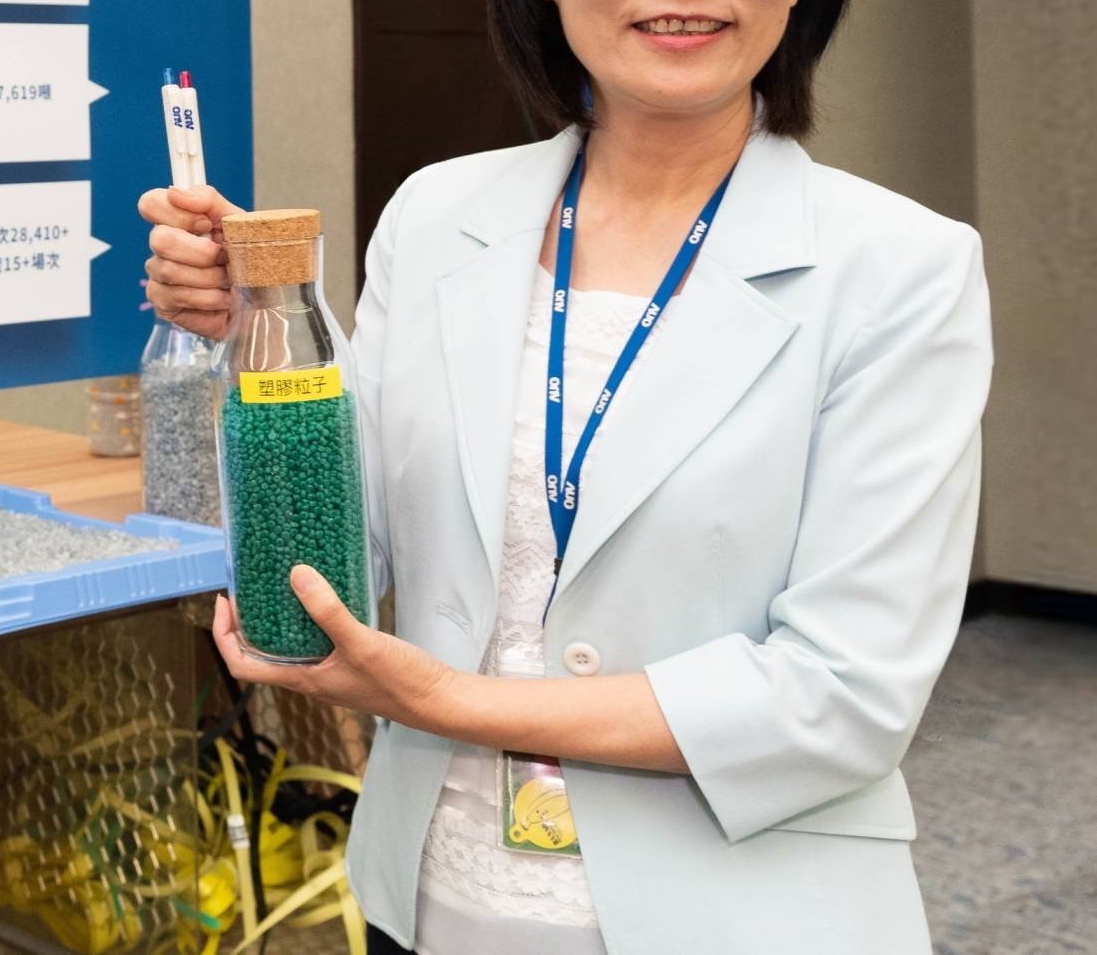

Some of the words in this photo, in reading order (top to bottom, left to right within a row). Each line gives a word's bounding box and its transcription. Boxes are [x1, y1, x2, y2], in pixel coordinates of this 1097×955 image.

[562, 207, 573, 229] AUO
[688, 219, 708, 244] AUO
[554, 289, 566, 313] AUO
[641, 302, 661, 328] AUO
[258, 375, 327, 397] 塑膠粒子
[548, 376, 561, 403] AUO
[595, 388, 612, 414] AUO
[547, 474, 558, 503] AUO
[563, 480, 575, 510] AUO
